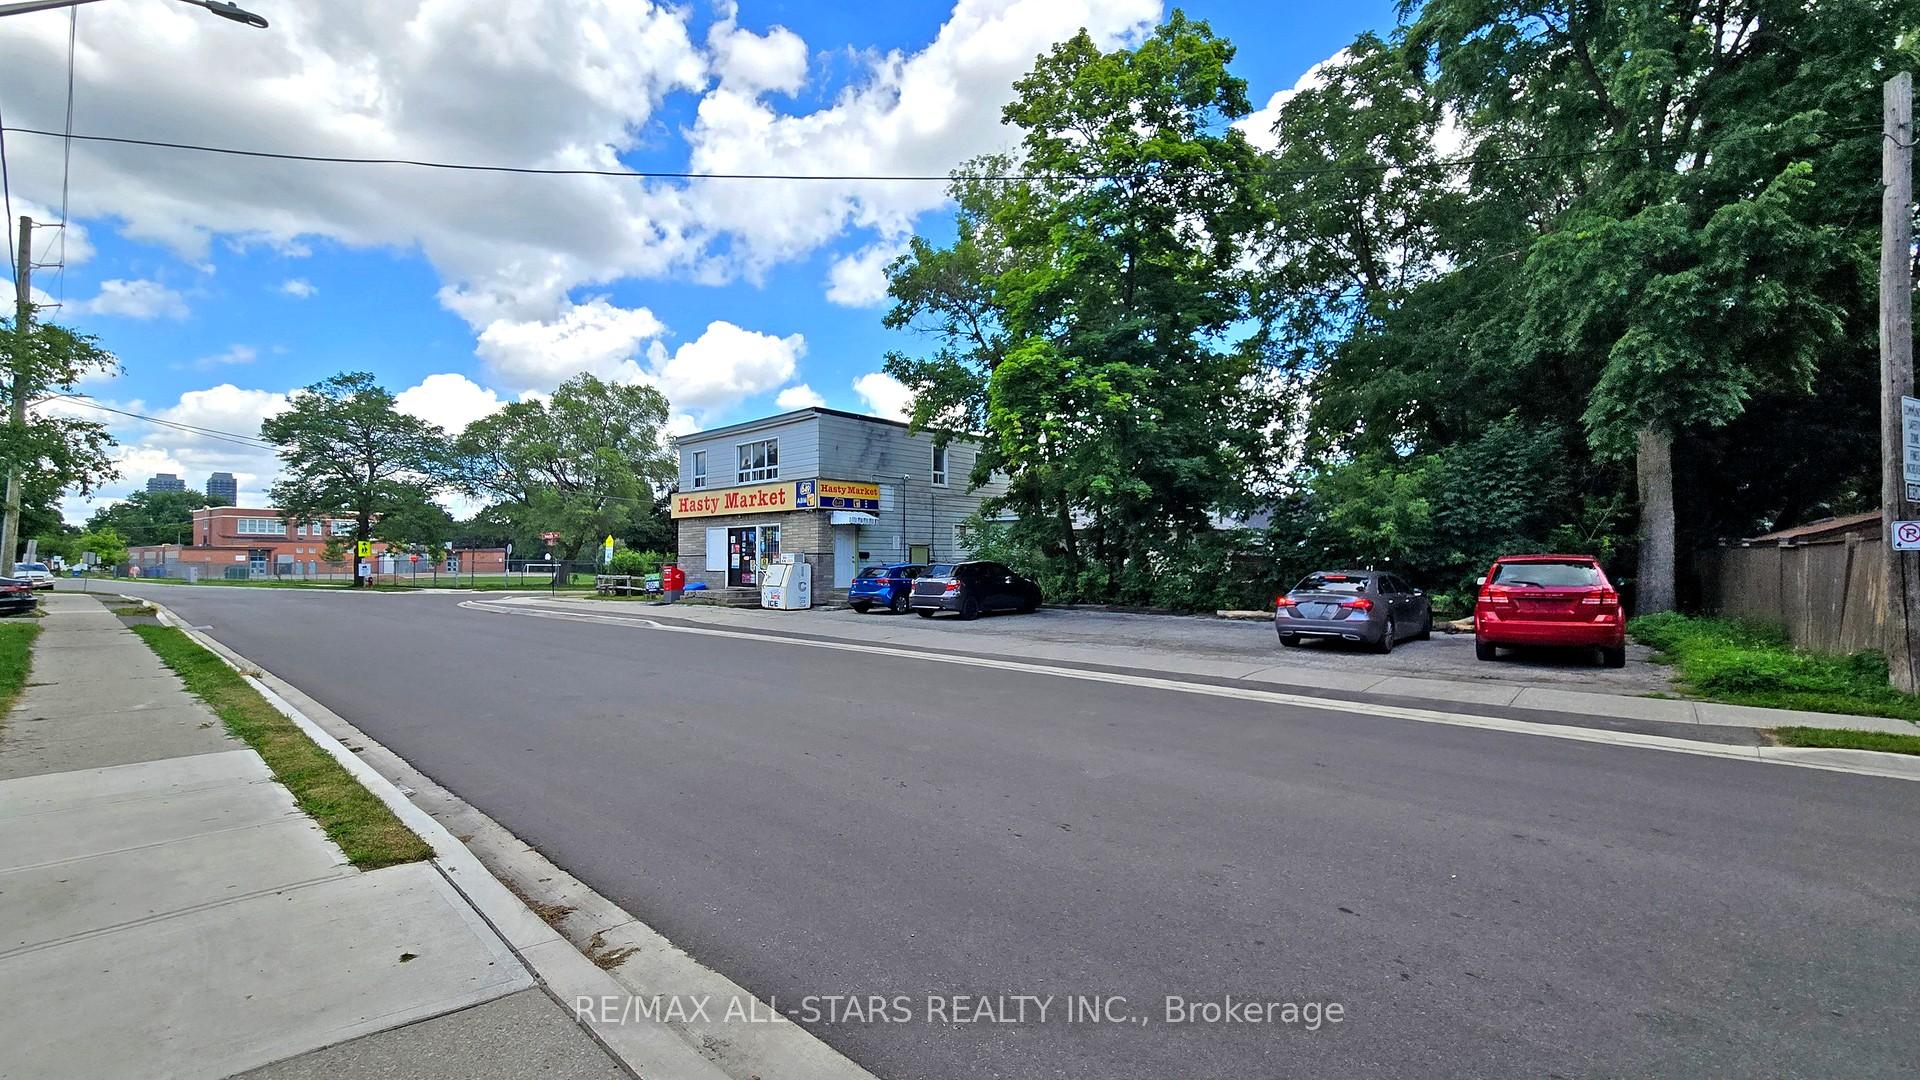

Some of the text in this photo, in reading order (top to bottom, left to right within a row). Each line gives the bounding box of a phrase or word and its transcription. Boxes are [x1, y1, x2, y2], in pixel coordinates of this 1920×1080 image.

[820, 484, 847, 495] Hasty
[847, 486, 878, 496] Market
[678, 488, 786, 513] Hasty Market
